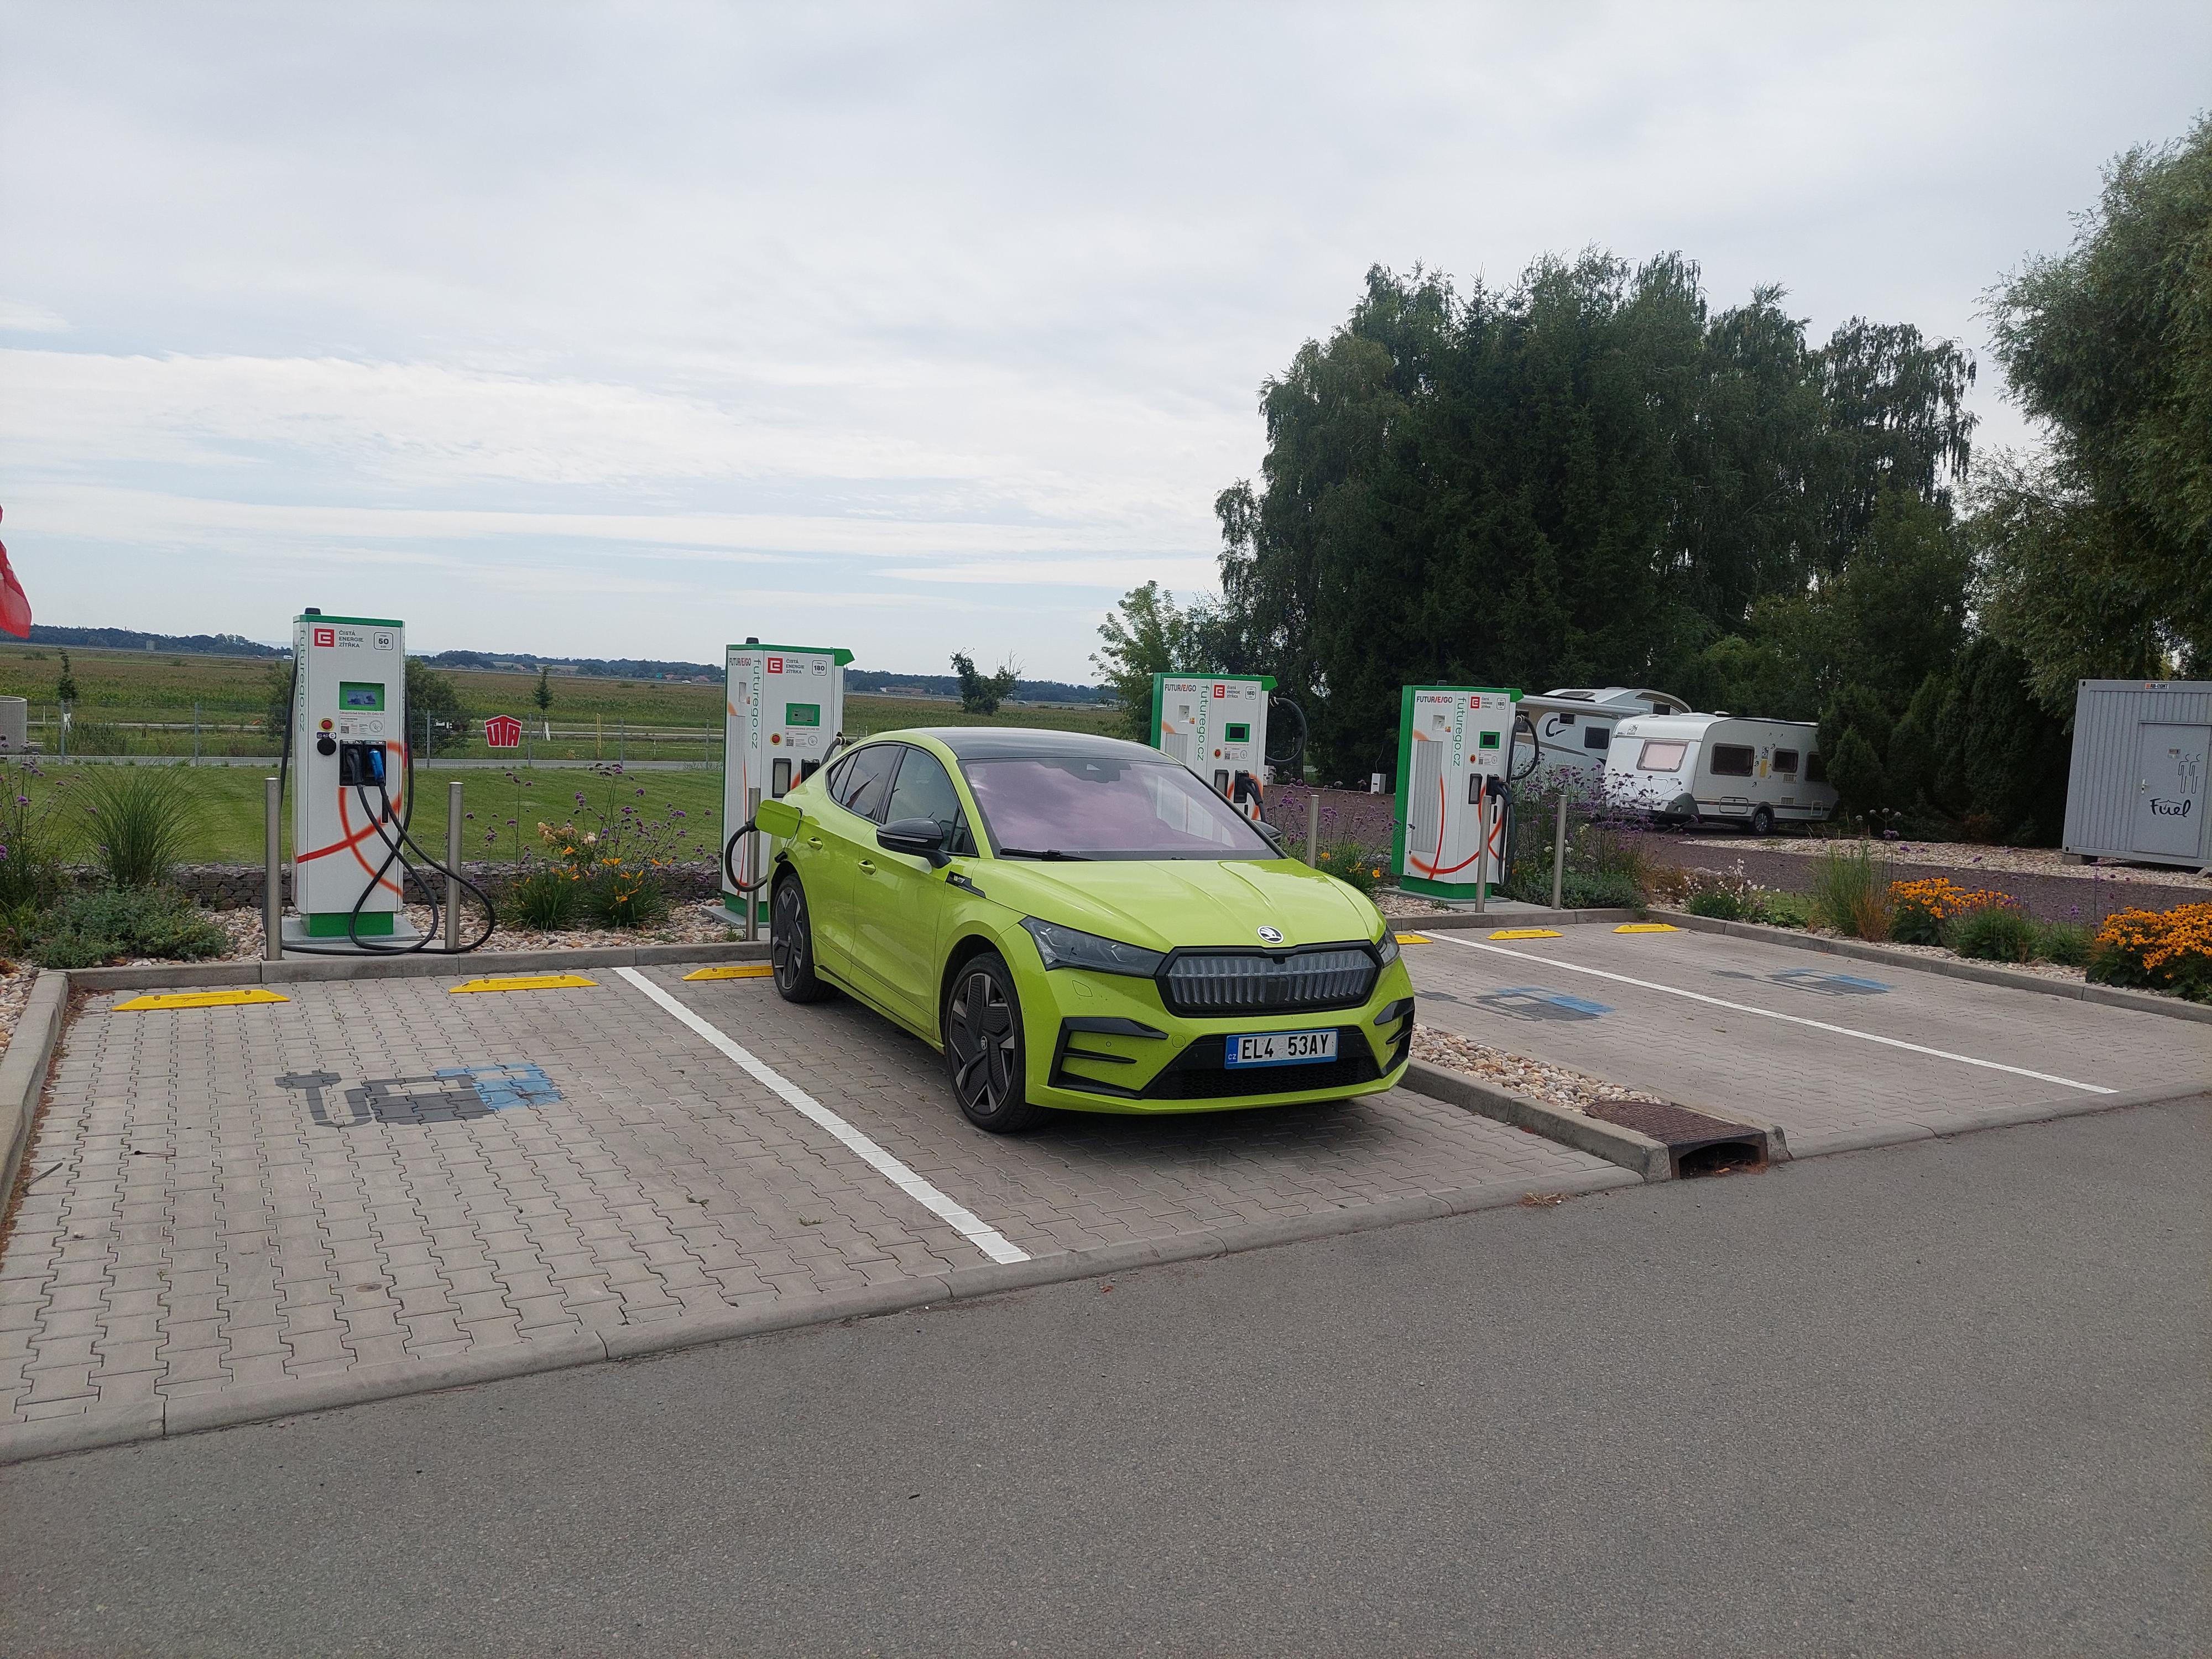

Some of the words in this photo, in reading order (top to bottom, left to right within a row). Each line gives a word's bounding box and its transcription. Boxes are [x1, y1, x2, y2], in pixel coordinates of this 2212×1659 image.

[751, 658, 761, 749] futurego.cz
[1165, 684, 1197, 692] FUTUR/E/GO
[485, 715, 522, 747] UTA
[1197, 685, 1210, 761] futurego.cz
[1453, 697, 1467, 766] futurego.cz
[2150, 798, 2191, 817] Fuel
[1242, 1037, 1274, 1060] EL4
[1288, 1034, 1329, 1056] 53AY
